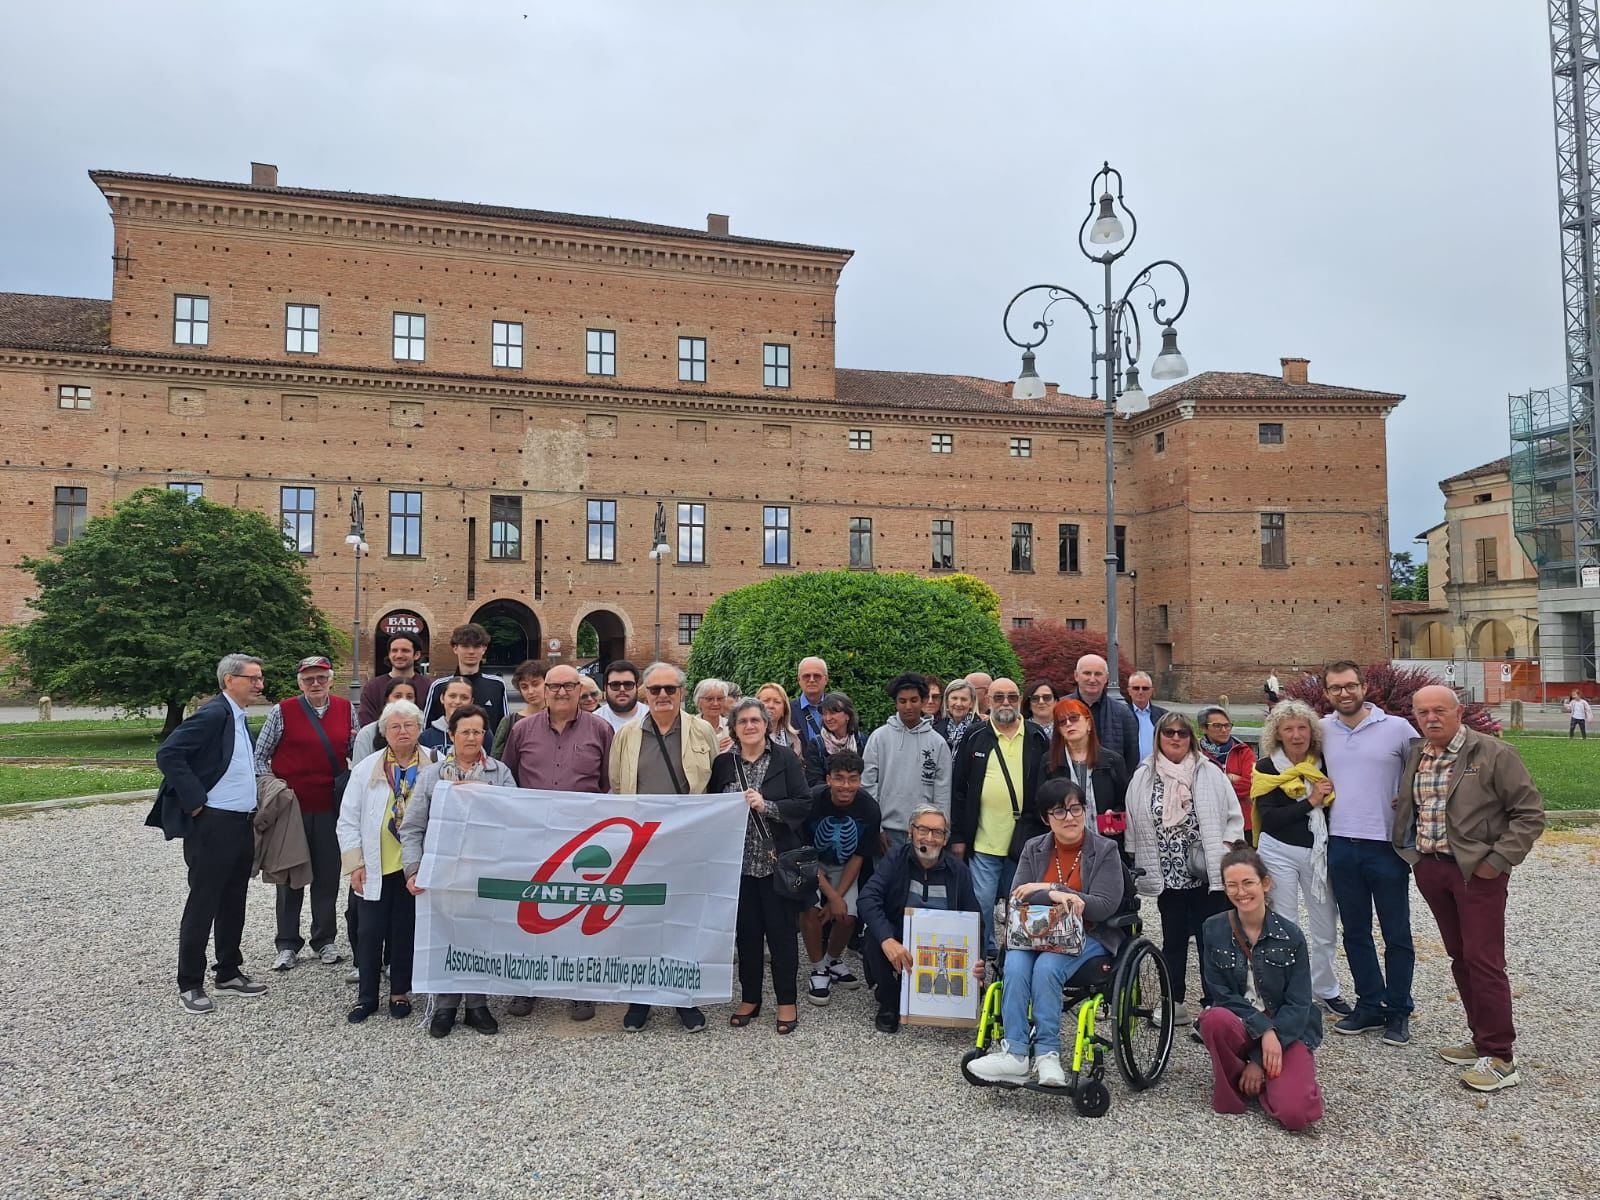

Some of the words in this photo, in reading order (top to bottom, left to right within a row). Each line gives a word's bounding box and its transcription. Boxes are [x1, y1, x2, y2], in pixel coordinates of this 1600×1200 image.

[388, 617, 417, 626] BAR
[444, 944, 501, 976] Associazione
[504, 953, 548, 982] Nazionale
[551, 955, 575, 983] Tutte
[576, 956, 583, 982] le
[587, 957, 602, 983] Età
[603, 956, 629, 984] Attive
[631, 963, 647, 991] per
[648, 957, 656, 985] la
[658, 958, 701, 989] Solidarietà
